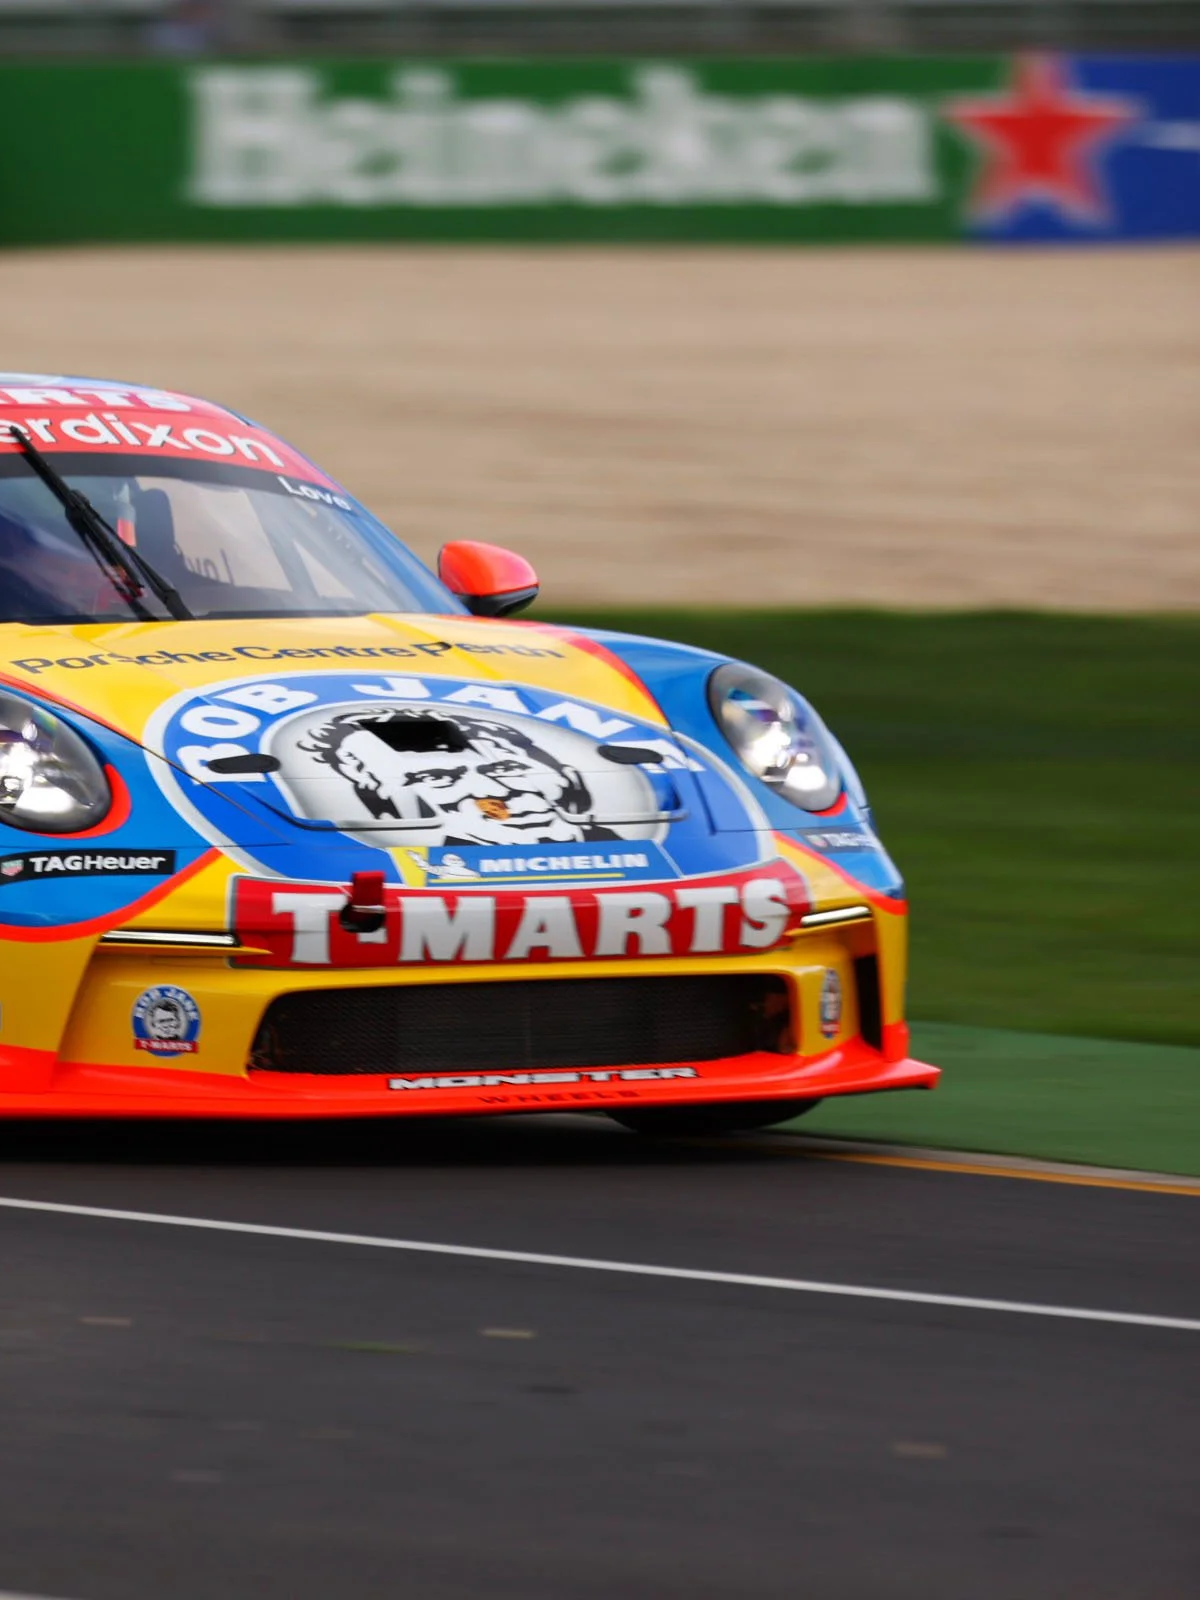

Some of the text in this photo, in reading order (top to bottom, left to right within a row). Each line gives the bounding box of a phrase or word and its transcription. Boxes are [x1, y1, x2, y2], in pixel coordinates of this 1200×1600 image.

[190, 66, 935, 205] Heineken
[278, 476, 352, 511] Love
[10, 641, 566, 674] Porsche Centre Perth
[177, 683, 320, 783] BOB
[478, 852, 650, 874] MICHELIN
[387, 1066, 700, 1091] MONSTER
[477, 1090, 641, 1104] WHEELS
